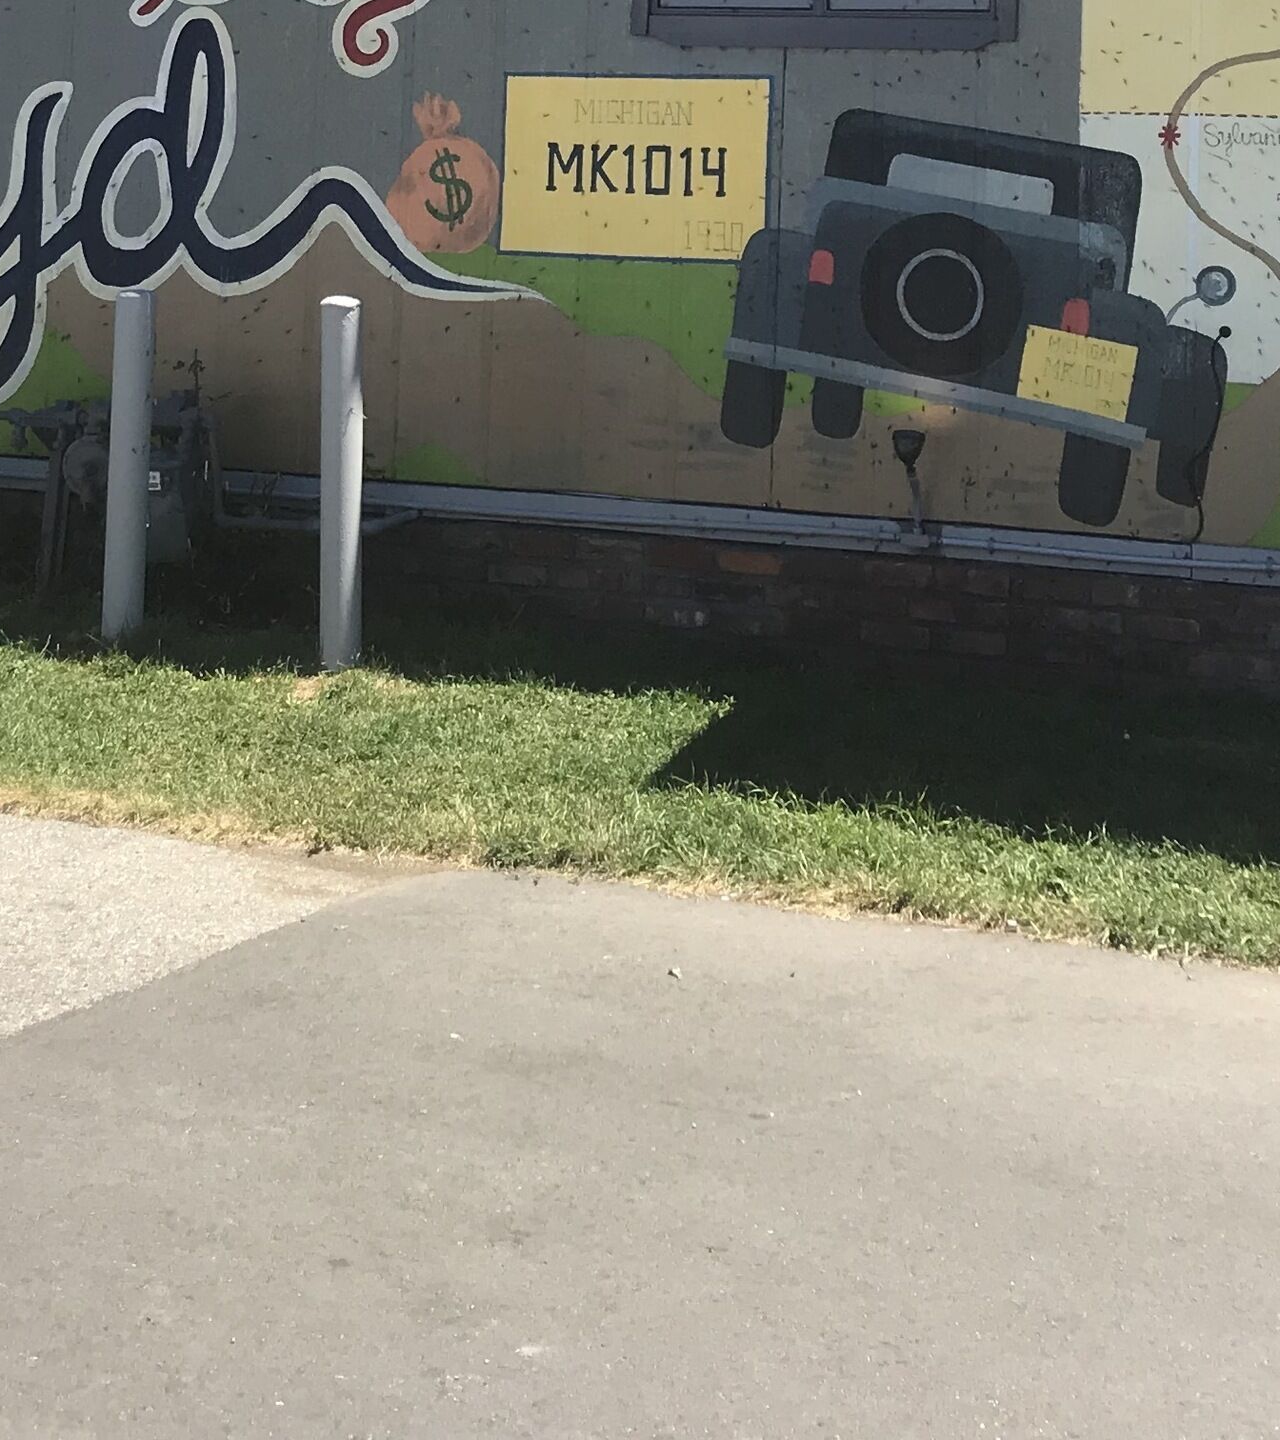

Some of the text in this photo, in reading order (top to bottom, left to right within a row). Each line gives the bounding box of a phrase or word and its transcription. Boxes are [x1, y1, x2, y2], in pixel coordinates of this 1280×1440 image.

[573, 98, 694, 126] MICHIGAN
[545, 143, 728, 198] MK1014
[684, 221, 744, 252] 1930
